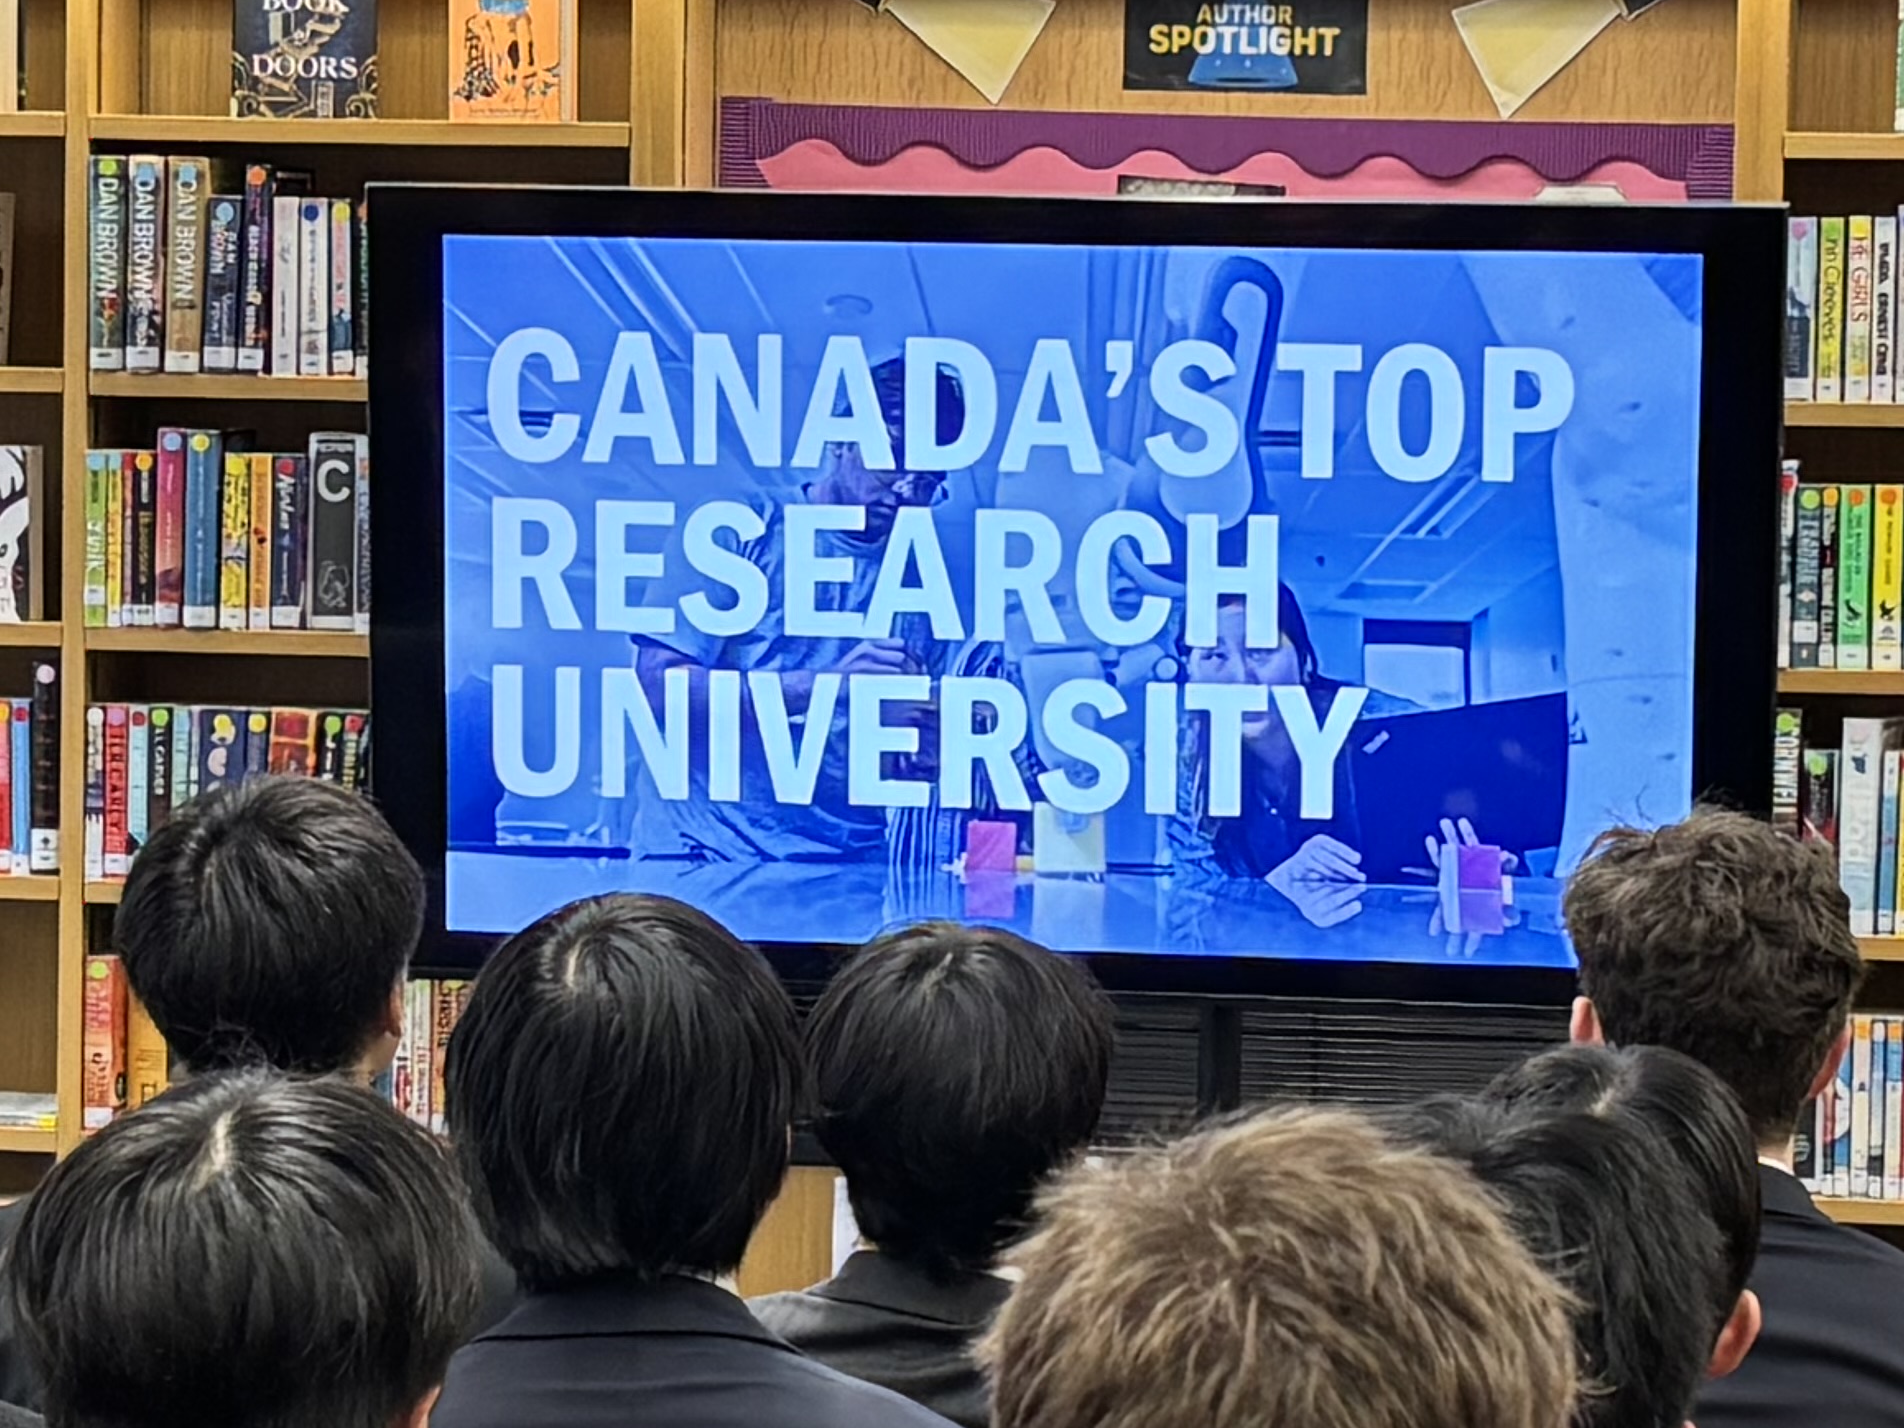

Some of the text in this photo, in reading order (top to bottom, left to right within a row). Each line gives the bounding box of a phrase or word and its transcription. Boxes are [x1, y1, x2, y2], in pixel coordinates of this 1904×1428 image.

[251, 54, 358, 80] DOORS
[1148, 24, 1341, 57] SPOTLIGHT
[1197, 3, 1293, 26] AUTHOR
[96, 177, 120, 299] DAN BROWN
[133, 178, 157, 299] DAN BROWN
[175, 181, 198, 301] DAN BROWN
[1850, 266, 1870, 323] GIRLS
[486, 325, 1577, 483] CANADA'S TOP
[317, 459, 351, 503] C
[490, 497, 1282, 648] RESEARCH
[490, 663, 1367, 820] UNIVERSITY
